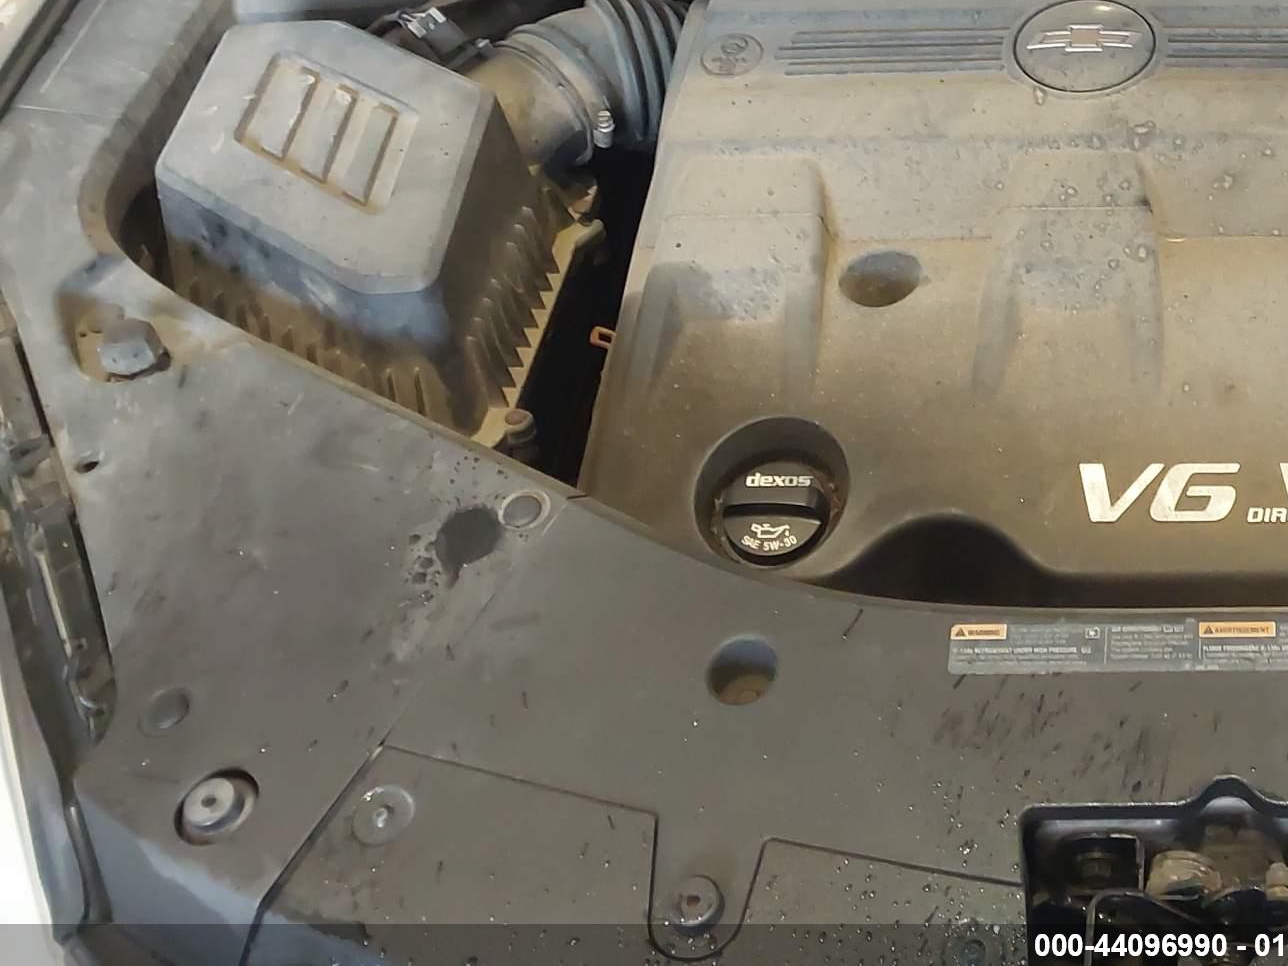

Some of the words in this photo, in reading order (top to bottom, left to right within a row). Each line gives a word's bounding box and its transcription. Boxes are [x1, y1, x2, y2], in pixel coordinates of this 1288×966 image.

[745, 472, 814, 487] dexos
[1079, 462, 1241, 523] V6
[741, 535, 761, 550] SAE
[762, 535, 798, 551] 5W-30
